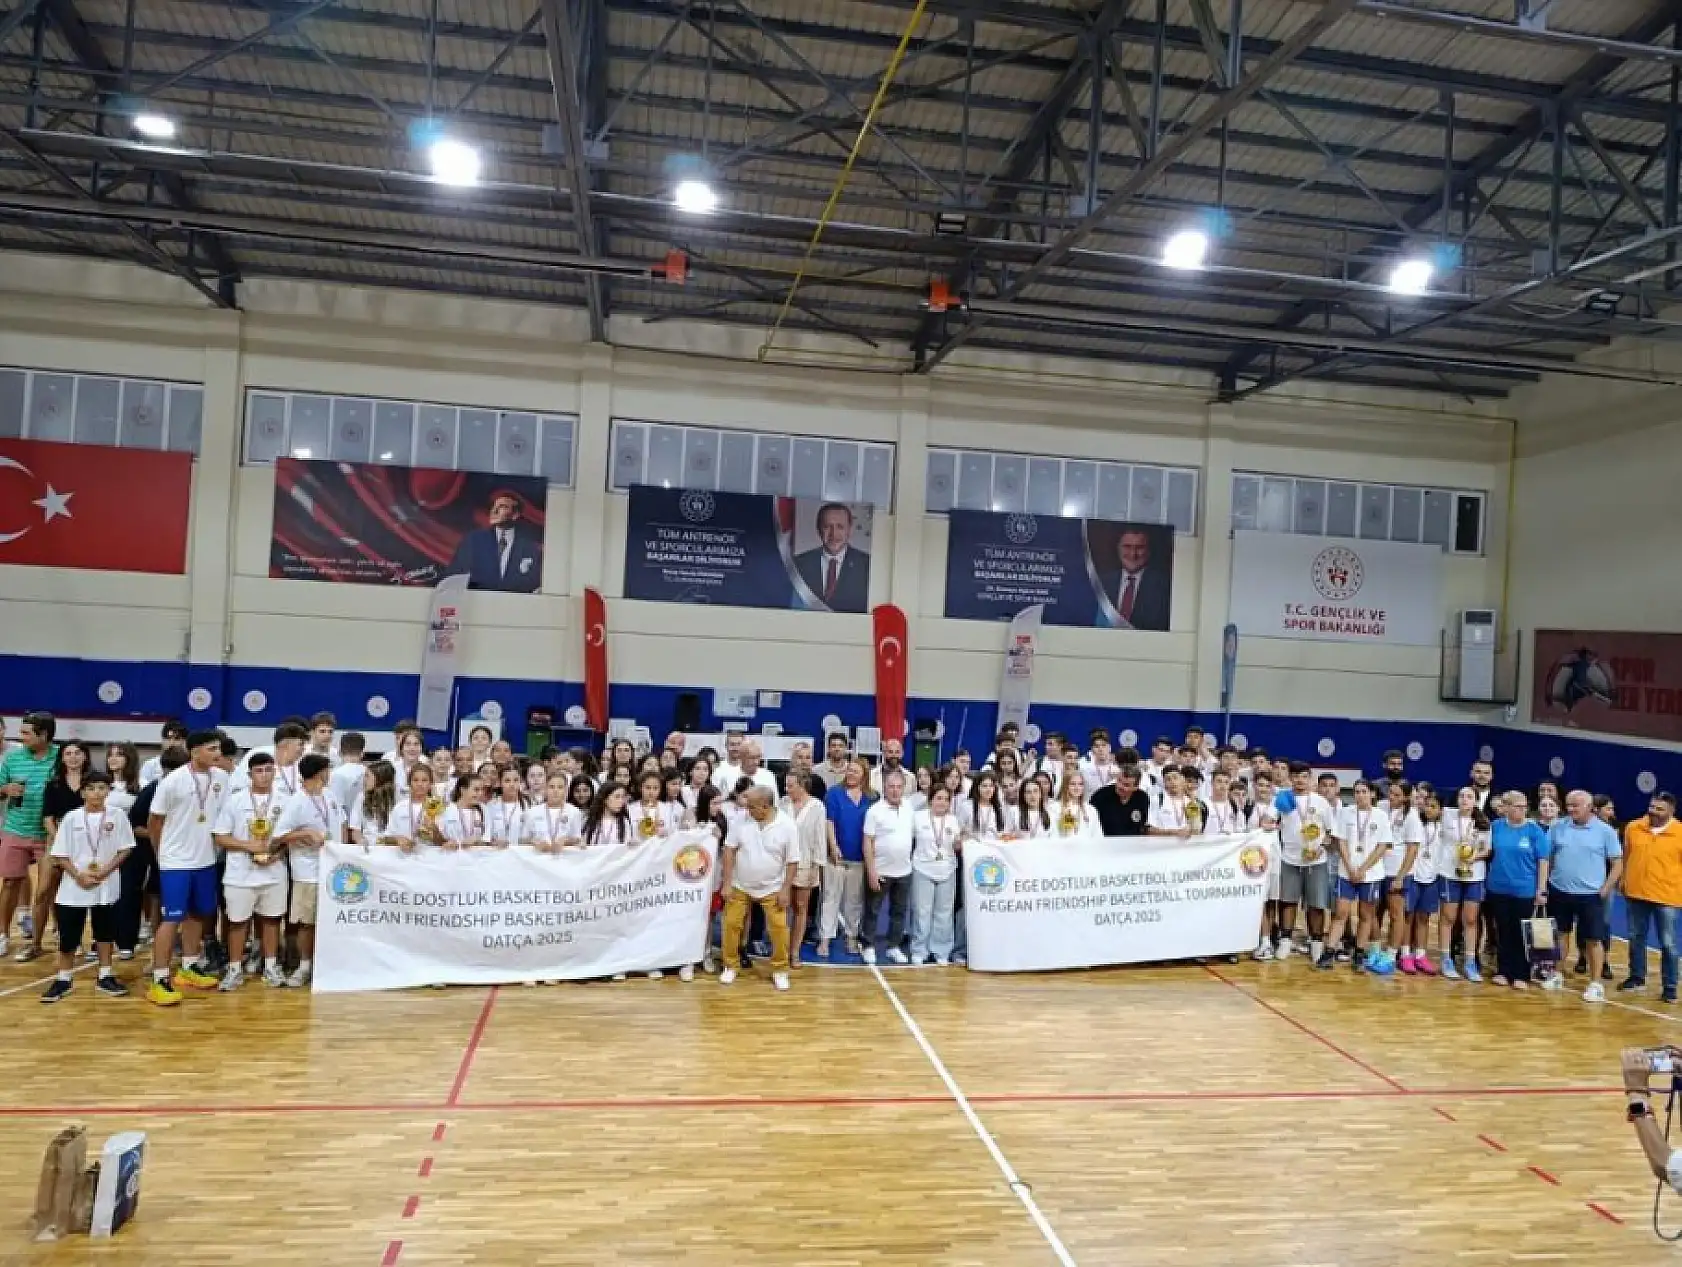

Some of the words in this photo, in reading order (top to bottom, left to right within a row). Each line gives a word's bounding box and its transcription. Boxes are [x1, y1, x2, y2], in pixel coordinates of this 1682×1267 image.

[656, 528, 680, 540] TÜM
[682, 532, 736, 544] ANTRENÖR
[645, 540, 657, 550] VE
[660, 541, 745, 557] SPORCULARIMIZA
[984, 547, 1005, 559] TÜM
[1008, 550, 1056, 562] ANTRENÖR
[973, 559, 984, 569] VE
[1284, 603, 1307, 616] T.C.
[1369, 609, 1387, 622] VE
[1284, 619, 1316, 631] SPOR
[1319, 621, 1386, 636] BAKANLIĞI
[1014, 878, 1039, 893] EGE
[1041, 876, 1097, 893] DOSTLUK
[1100, 873, 1168, 888] BASKETBOL
[378, 889, 409, 904] EGE
[413, 888, 488, 907] DOSTLUK
[492, 887, 582, 904] BASKETBOL
[979, 899, 1033, 913] AEGEAN
[1036, 894, 1106, 911] FRIENDSHIP
[1110, 889, 1182, 907] BASKETBALL
[1186, 884, 1262, 902] TOURNAMENT
[336, 909, 401, 924] AEGEAN
[405, 911, 501, 929] FRIENDSHIP
[505, 906, 601, 926] BASKETBALL
[604, 889, 704, 916] TOURNAMENT
[1094, 913, 1132, 929] DATÇA
[1134, 910, 1162, 924] 2025
[482, 932, 534, 950] DATÇA
[537, 930, 573, 947] 2025
